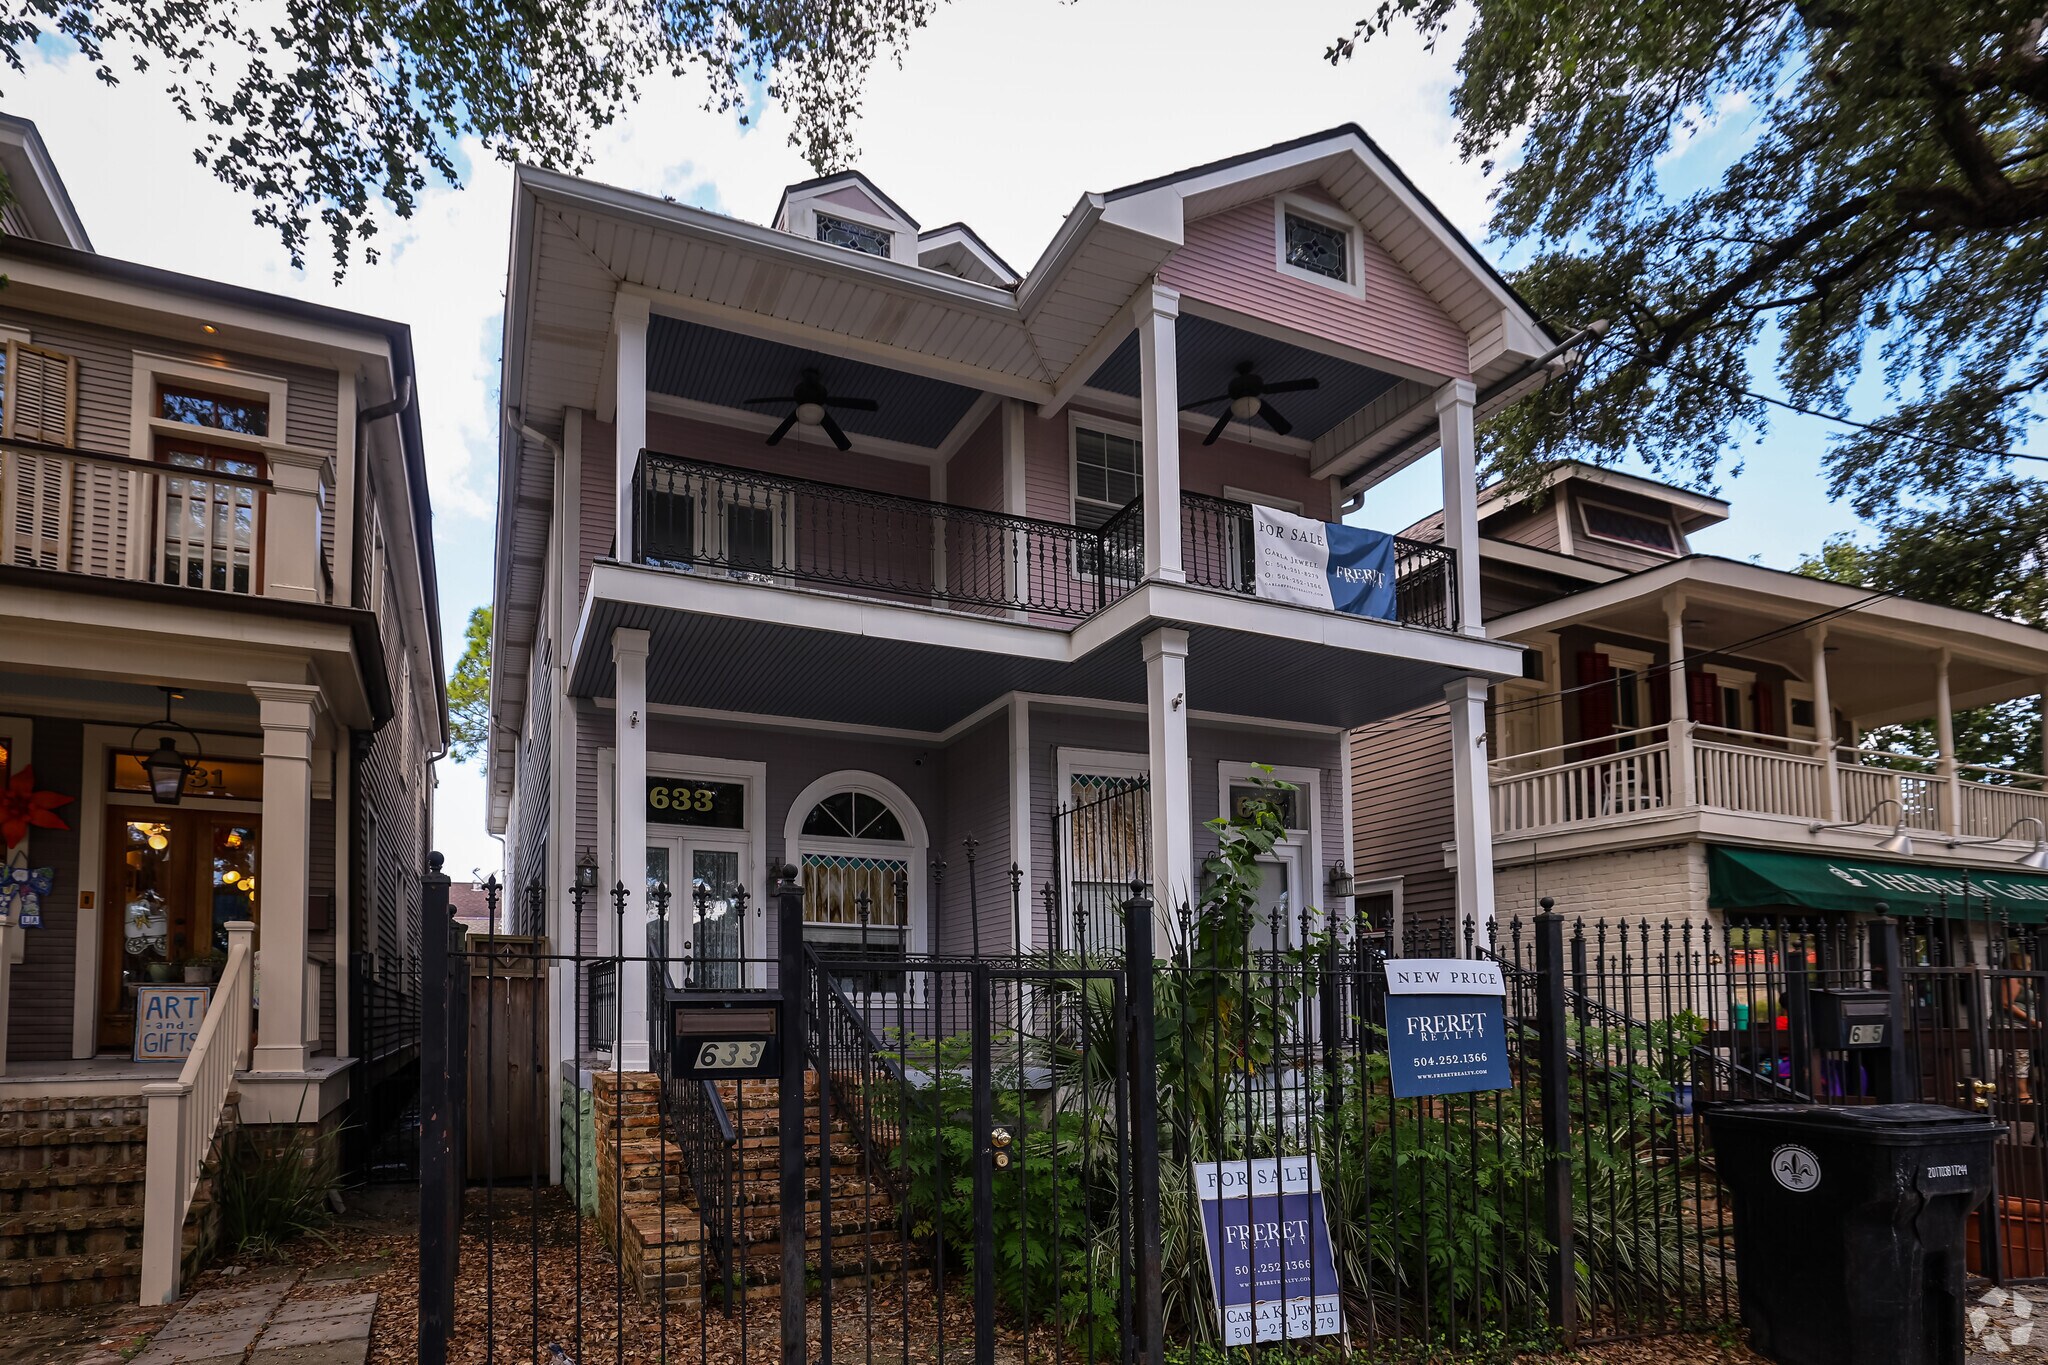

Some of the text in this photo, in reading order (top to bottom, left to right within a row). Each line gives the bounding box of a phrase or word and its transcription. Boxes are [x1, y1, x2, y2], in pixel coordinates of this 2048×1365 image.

[1258, 520, 1325, 547] FOR SALE
[1264, 547, 1319, 569] CARLA JEWELL
[649, 786, 714, 812] 633
[1397, 971, 1498, 985] NEW PRICE
[146, 995, 200, 1020] ART
[1406, 1012, 1487, 1036] FRERET
[1421, 1028, 1485, 1042] REALTY
[700, 1043, 761, 1067] 633
[1413, 1052, 1488, 1067] 504.252.1366
[1207, 1166, 1309, 1188] FOR SALE
[1225, 1219, 1309, 1245] FRERET
[1235, 1259, 1311, 1276] 50.2521366
[1234, 1317, 1335, 1339] 50-251-879
